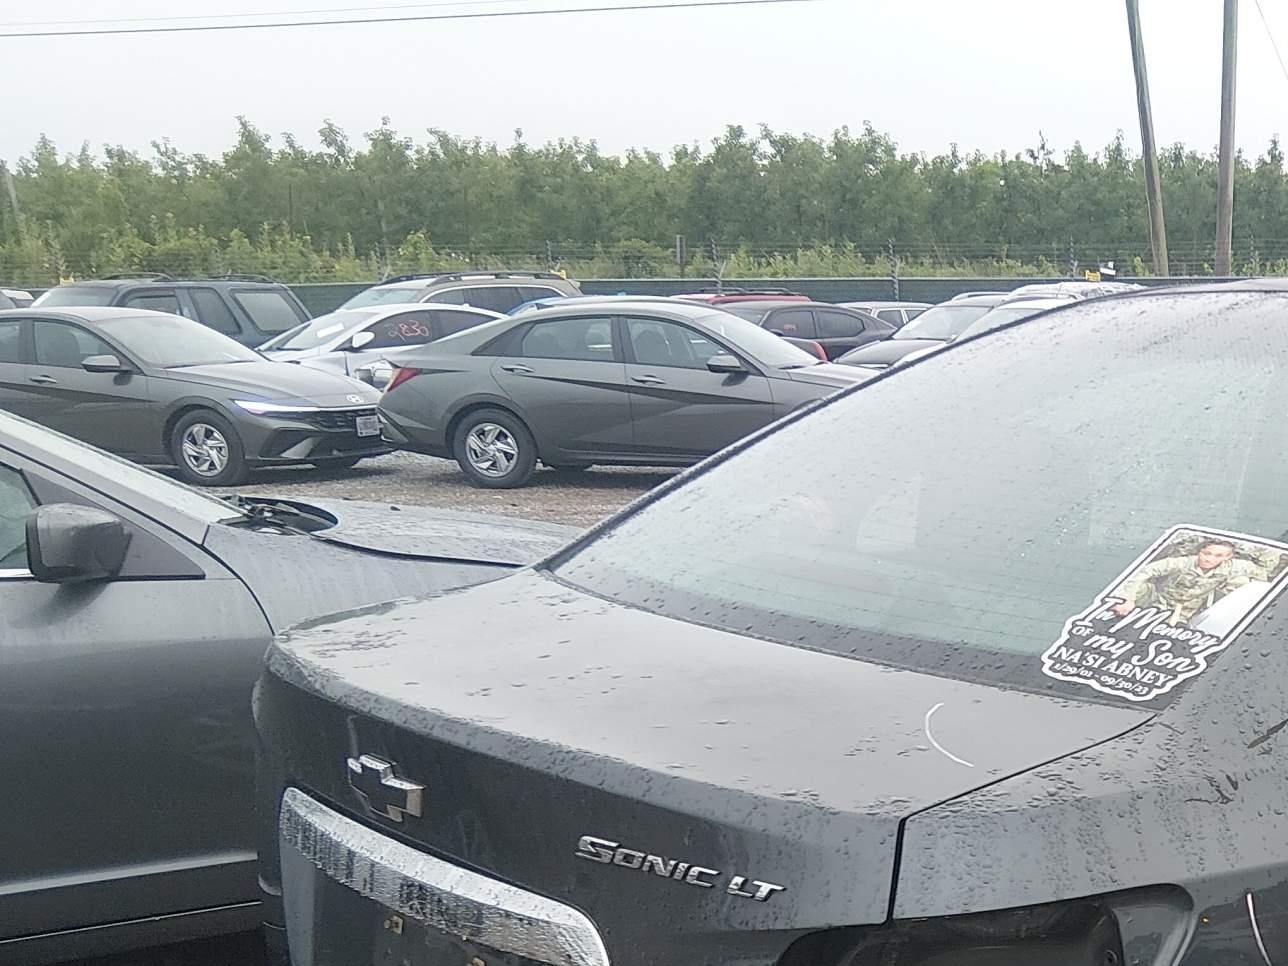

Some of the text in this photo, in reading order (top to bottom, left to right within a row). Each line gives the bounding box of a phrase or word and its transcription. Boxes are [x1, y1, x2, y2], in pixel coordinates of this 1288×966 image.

[1075, 597, 1220, 653] In Memory
[1053, 646, 1173, 687] NA'SI ABNEY
[1131, 639, 1197, 672] Son
[1100, 675, 1149, 694] 09/30/23
[575, 835, 786, 901] SONIC LT
